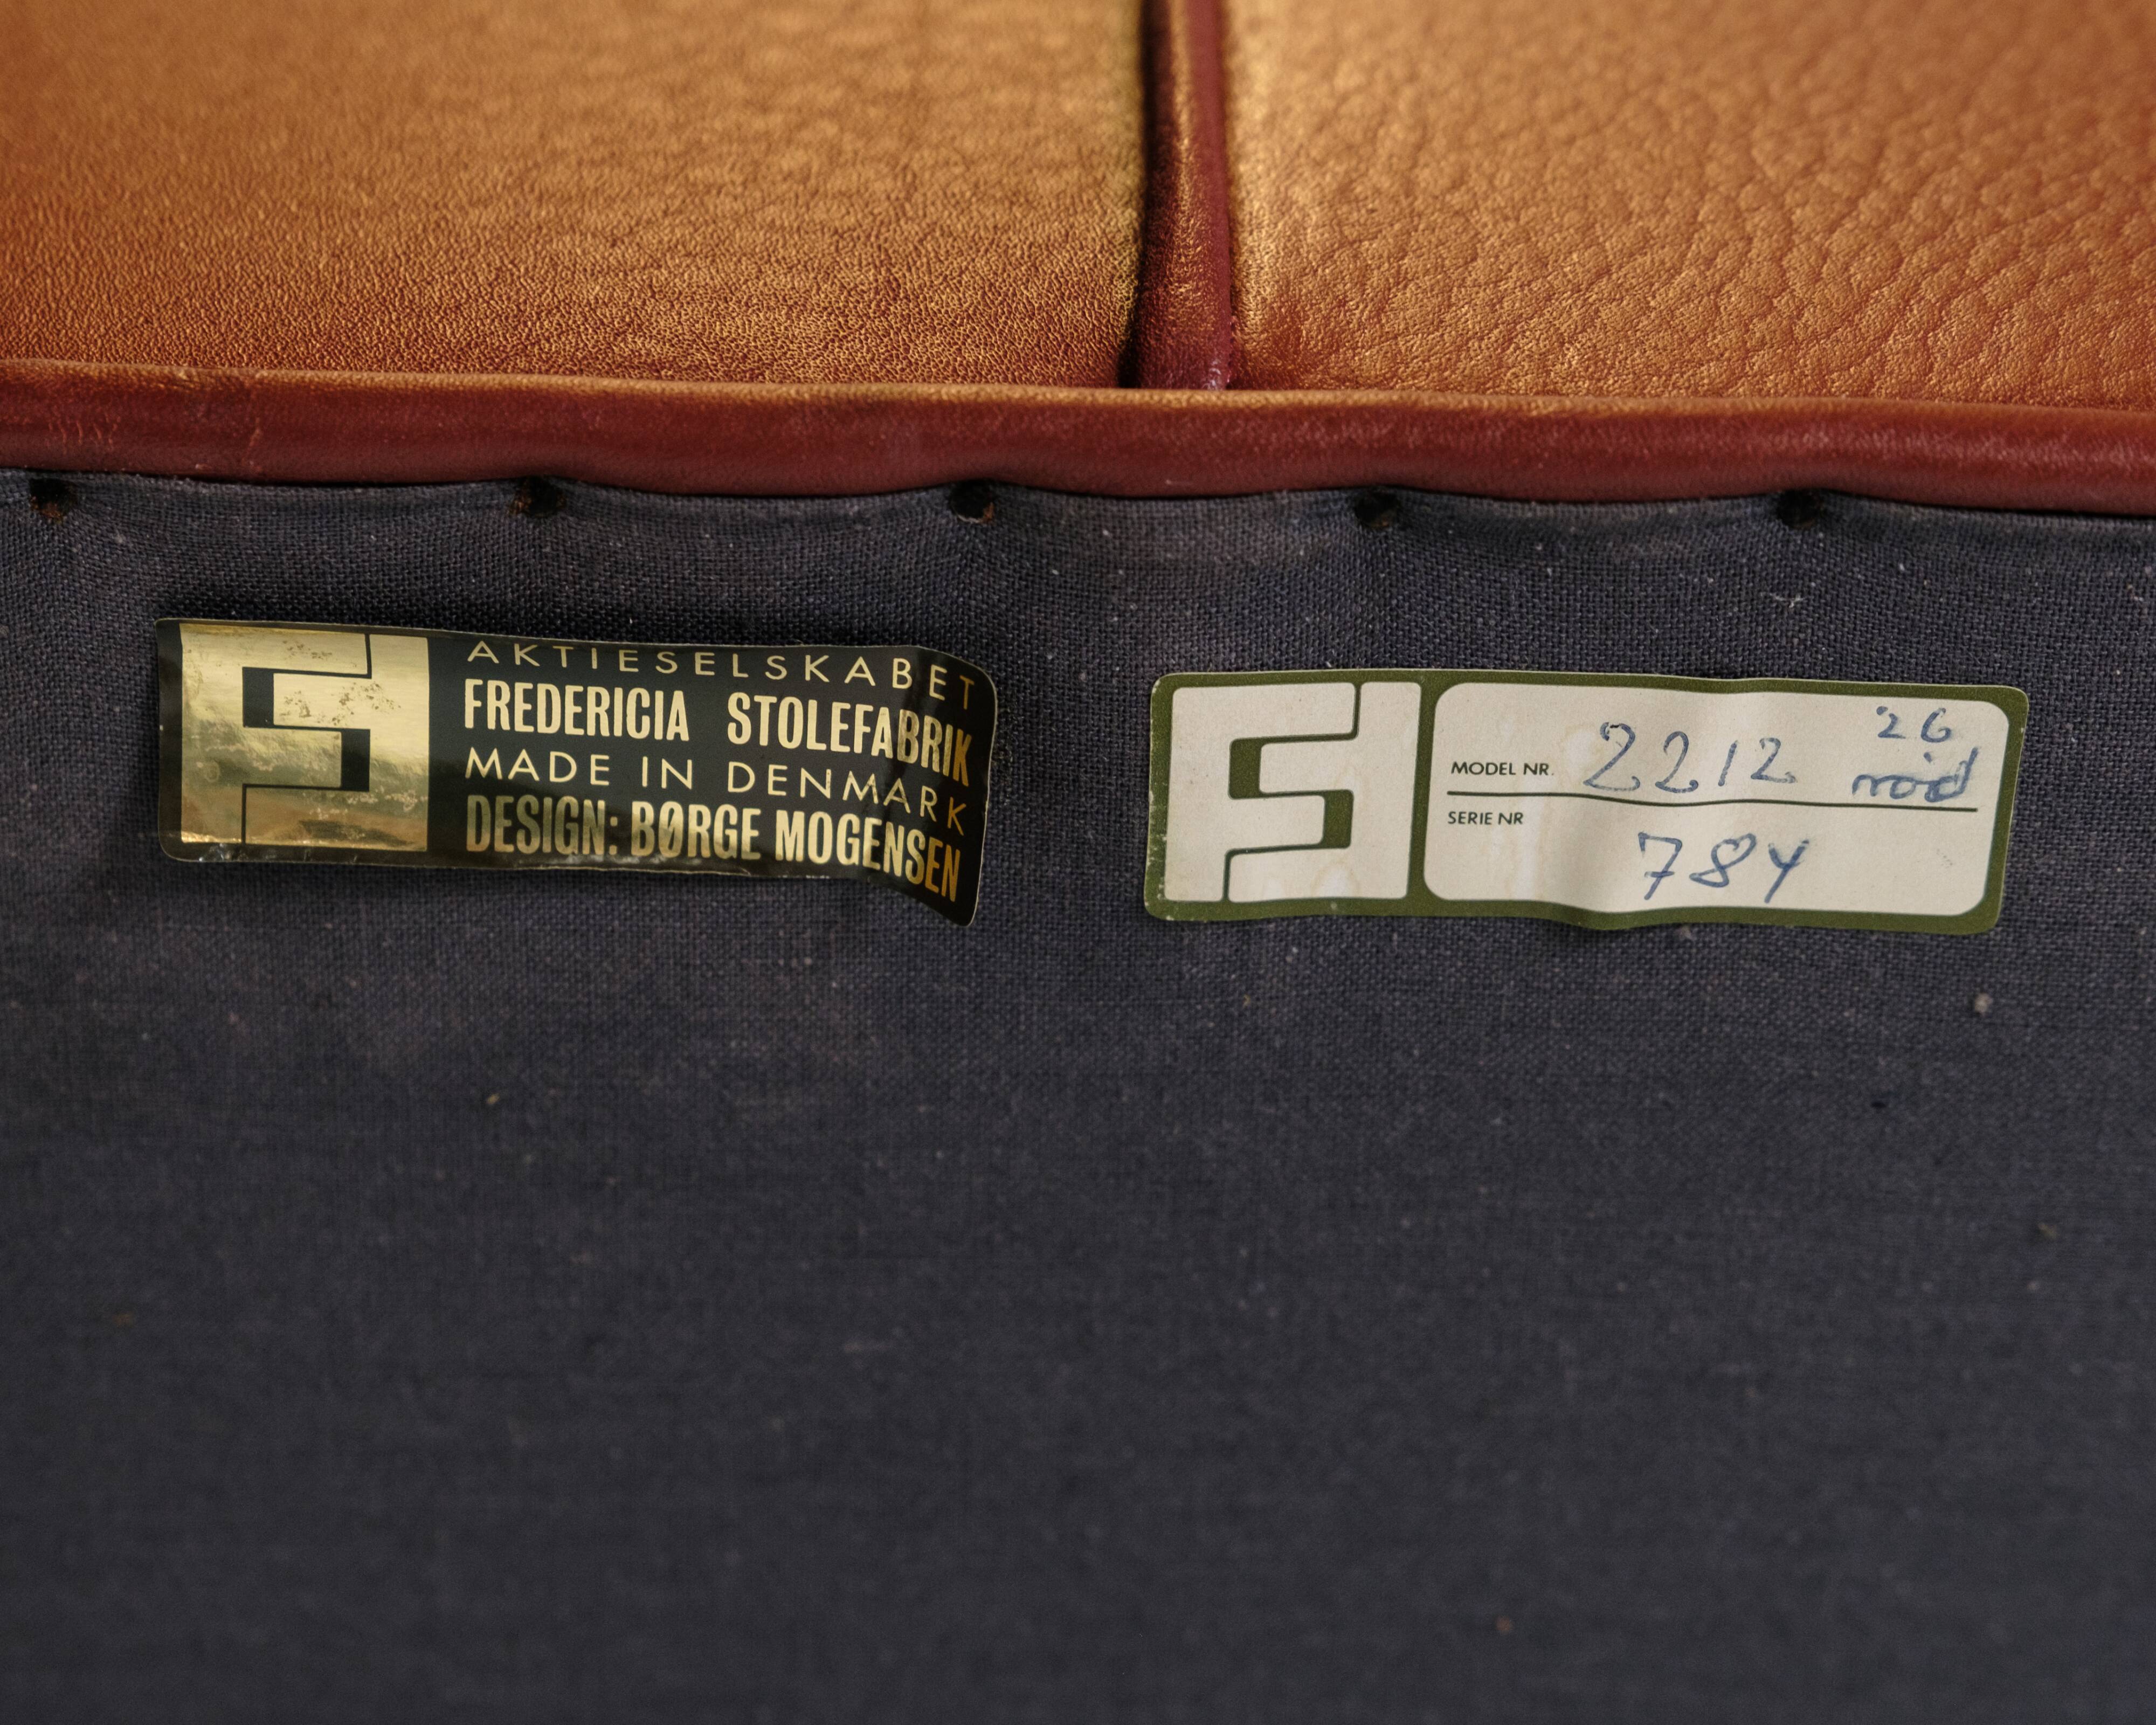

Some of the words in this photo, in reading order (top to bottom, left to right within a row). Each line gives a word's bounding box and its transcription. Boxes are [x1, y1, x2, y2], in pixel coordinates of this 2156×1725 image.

[467, 640, 975, 711] AKTIESELSKABET
[465, 678, 689, 741] FREDERICIA
[728, 692, 972, 788] STOLEFABRIK
[1451, 761, 1516, 775] MODEL
[1523, 763, 1555, 775] NR.
[1583, 722, 1798, 794] 2212
[465, 747, 610, 786] MADE
[641, 756, 694, 789] IN
[728, 761, 966, 837] DENMARK
[1448, 811, 1493, 825] SERIE
[1498, 812, 1524, 825] NR
[466, 795, 619, 857] DESIGN:
[631, 800, 761, 860] BØRGE
[775, 809, 961, 902] MOGENSEN
